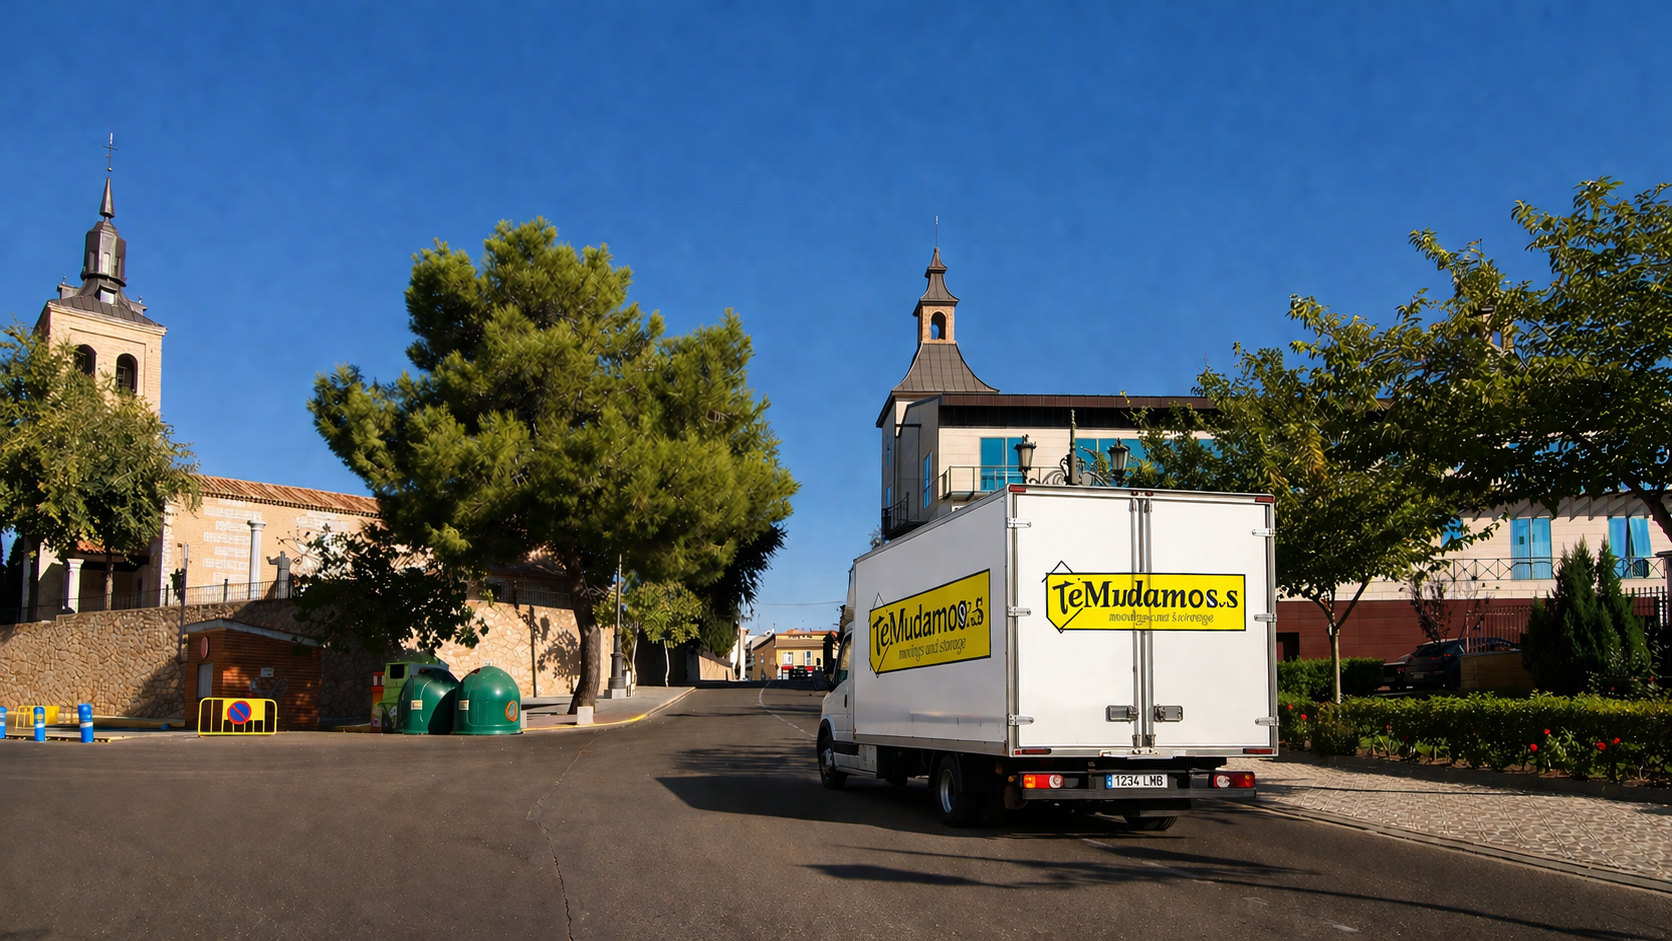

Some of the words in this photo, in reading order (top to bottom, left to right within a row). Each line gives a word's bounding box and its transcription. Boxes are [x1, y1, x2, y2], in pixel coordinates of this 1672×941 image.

[925, 638, 939, 655] and
[939, 637, 967, 655] storage
[1115, 775, 1140, 787] 1234
